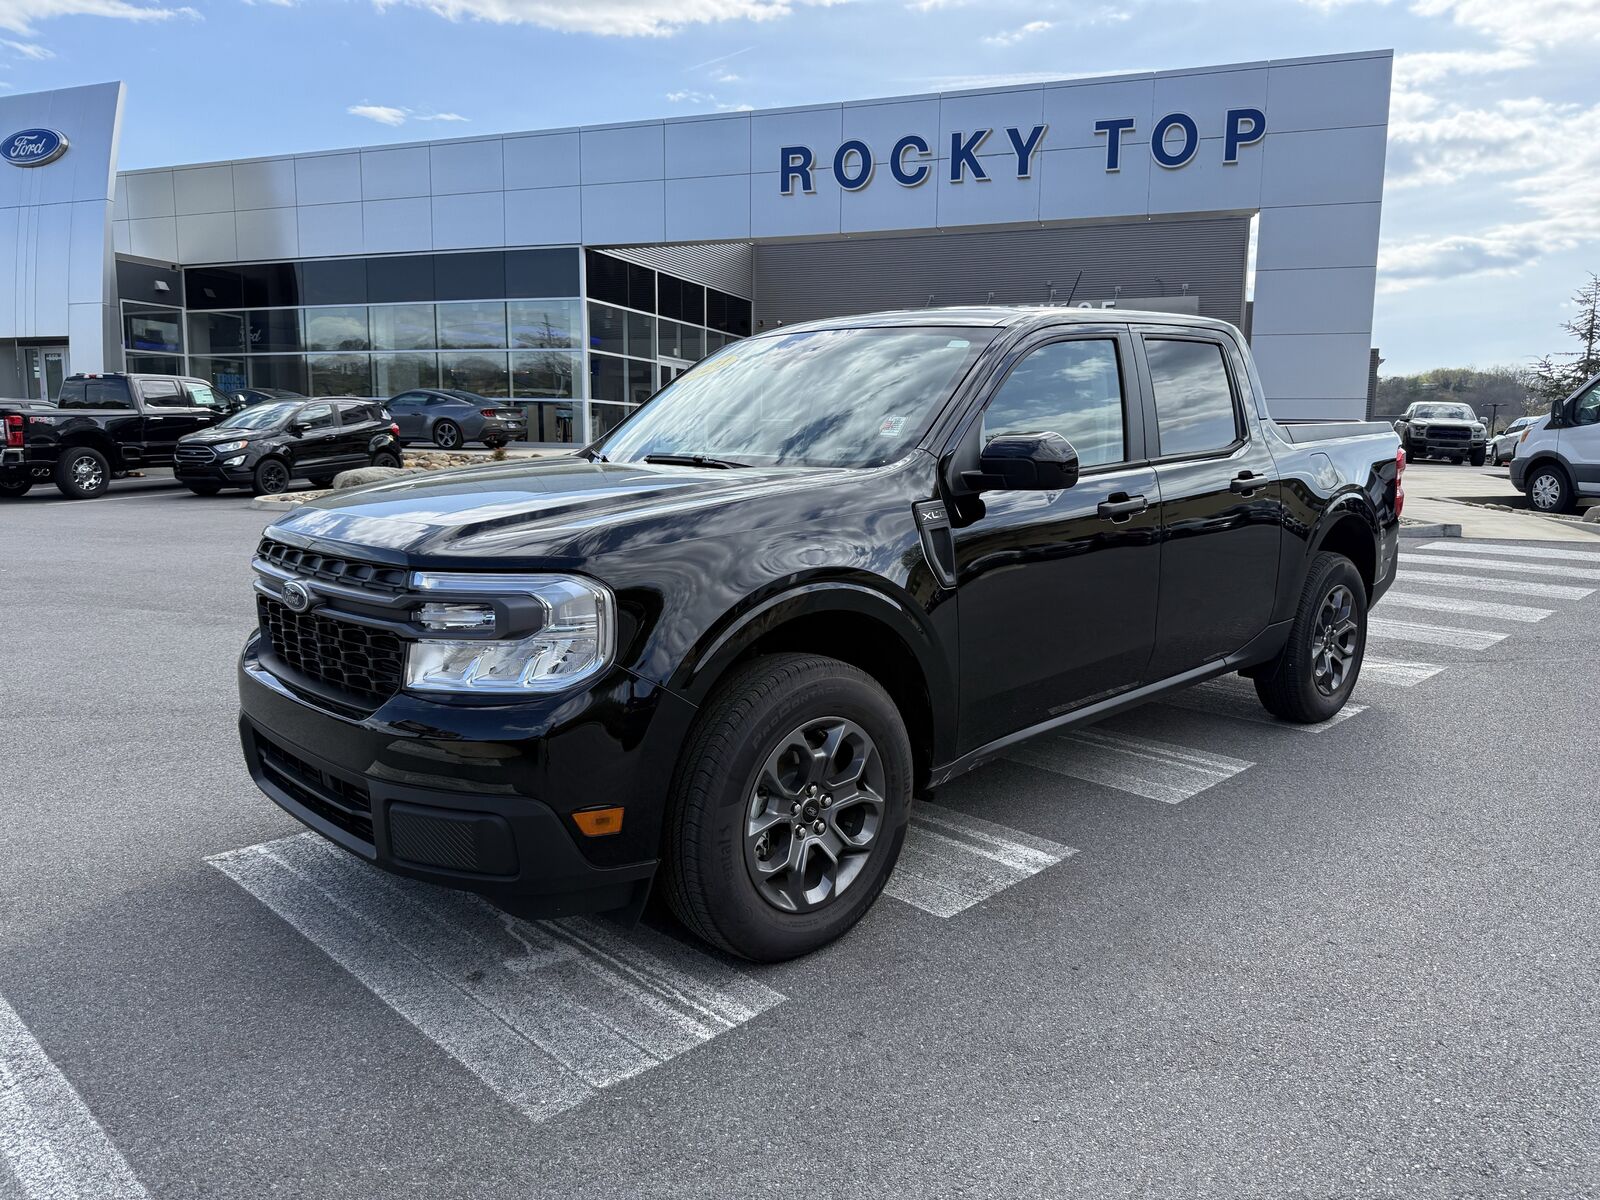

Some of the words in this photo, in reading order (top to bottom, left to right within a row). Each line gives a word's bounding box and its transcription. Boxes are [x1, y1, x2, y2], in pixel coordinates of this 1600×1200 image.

[10, 134, 47, 157] Ford
[780, 123, 1048, 195] ROCKY
[1094, 107, 1268, 172] TOP
